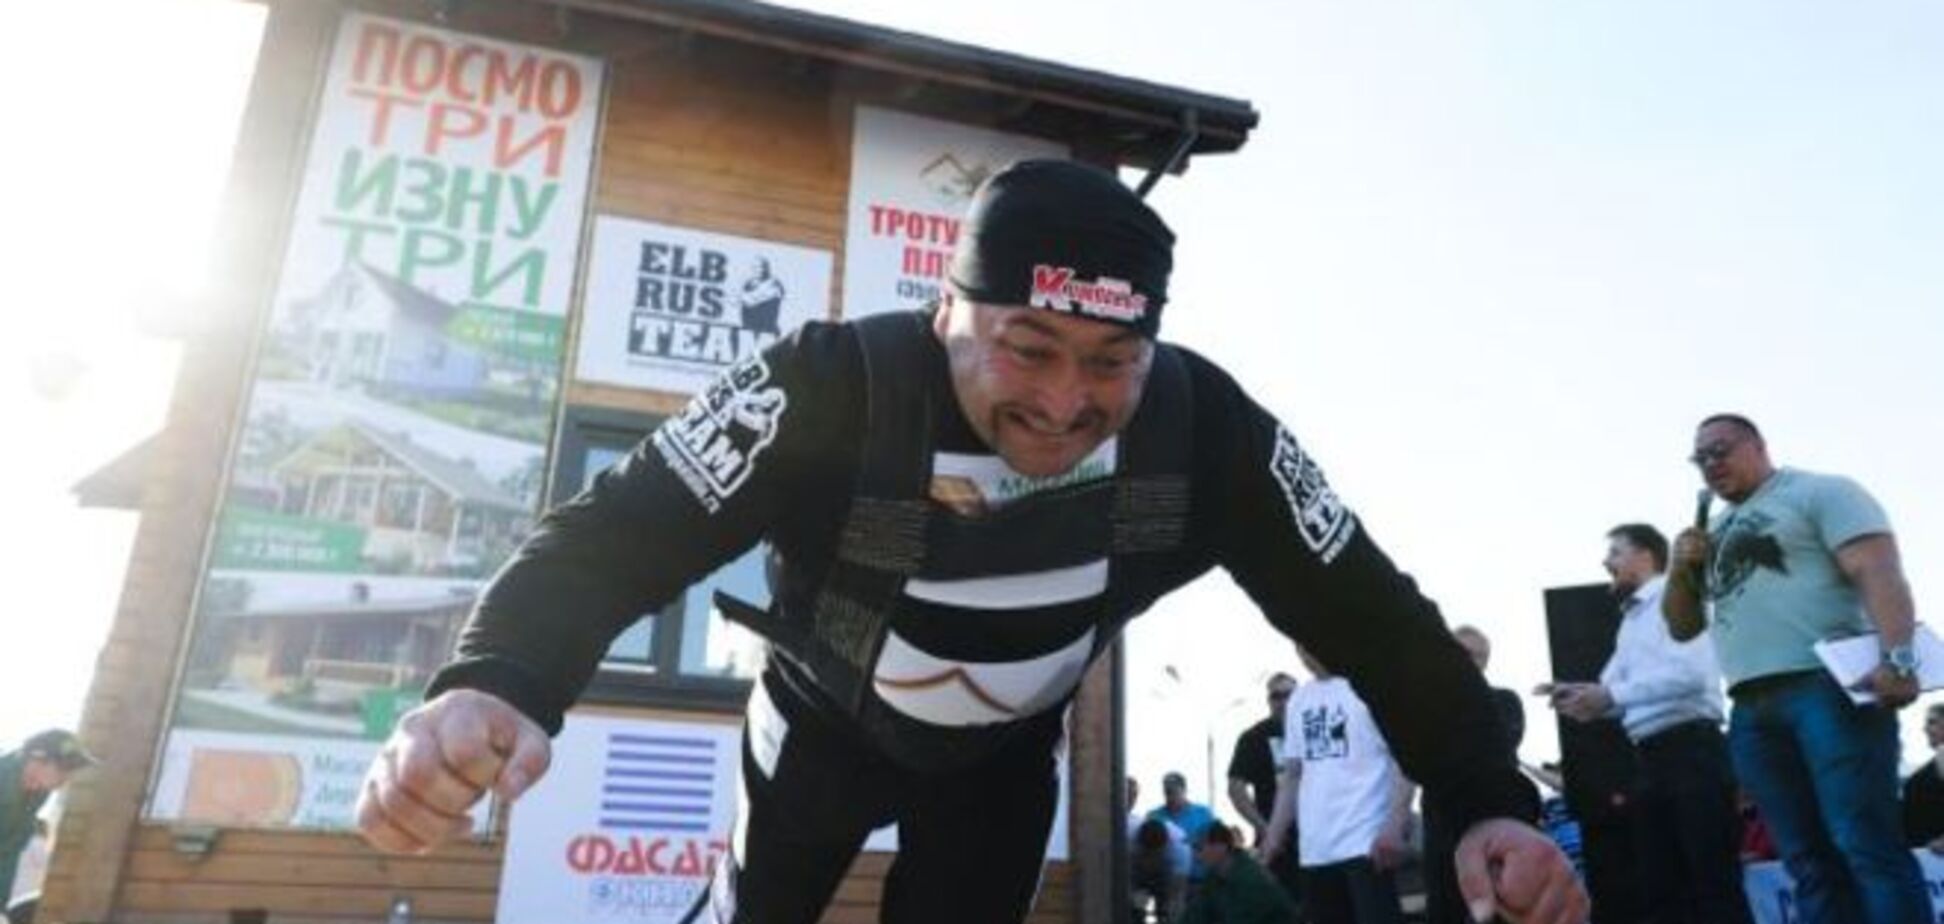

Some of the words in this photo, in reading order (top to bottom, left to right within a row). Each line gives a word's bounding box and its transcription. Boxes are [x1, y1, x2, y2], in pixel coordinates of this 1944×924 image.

[352, 23, 582, 120] ПОСМО
[348, 87, 567, 178] ТРИ
[335, 148, 560, 241] ИЗНУ
[320, 215, 547, 307] ТРИ
[635, 276, 724, 318] RUS
[639, 241, 727, 283] ELB
[903, 246, 950, 279] ПЛ
